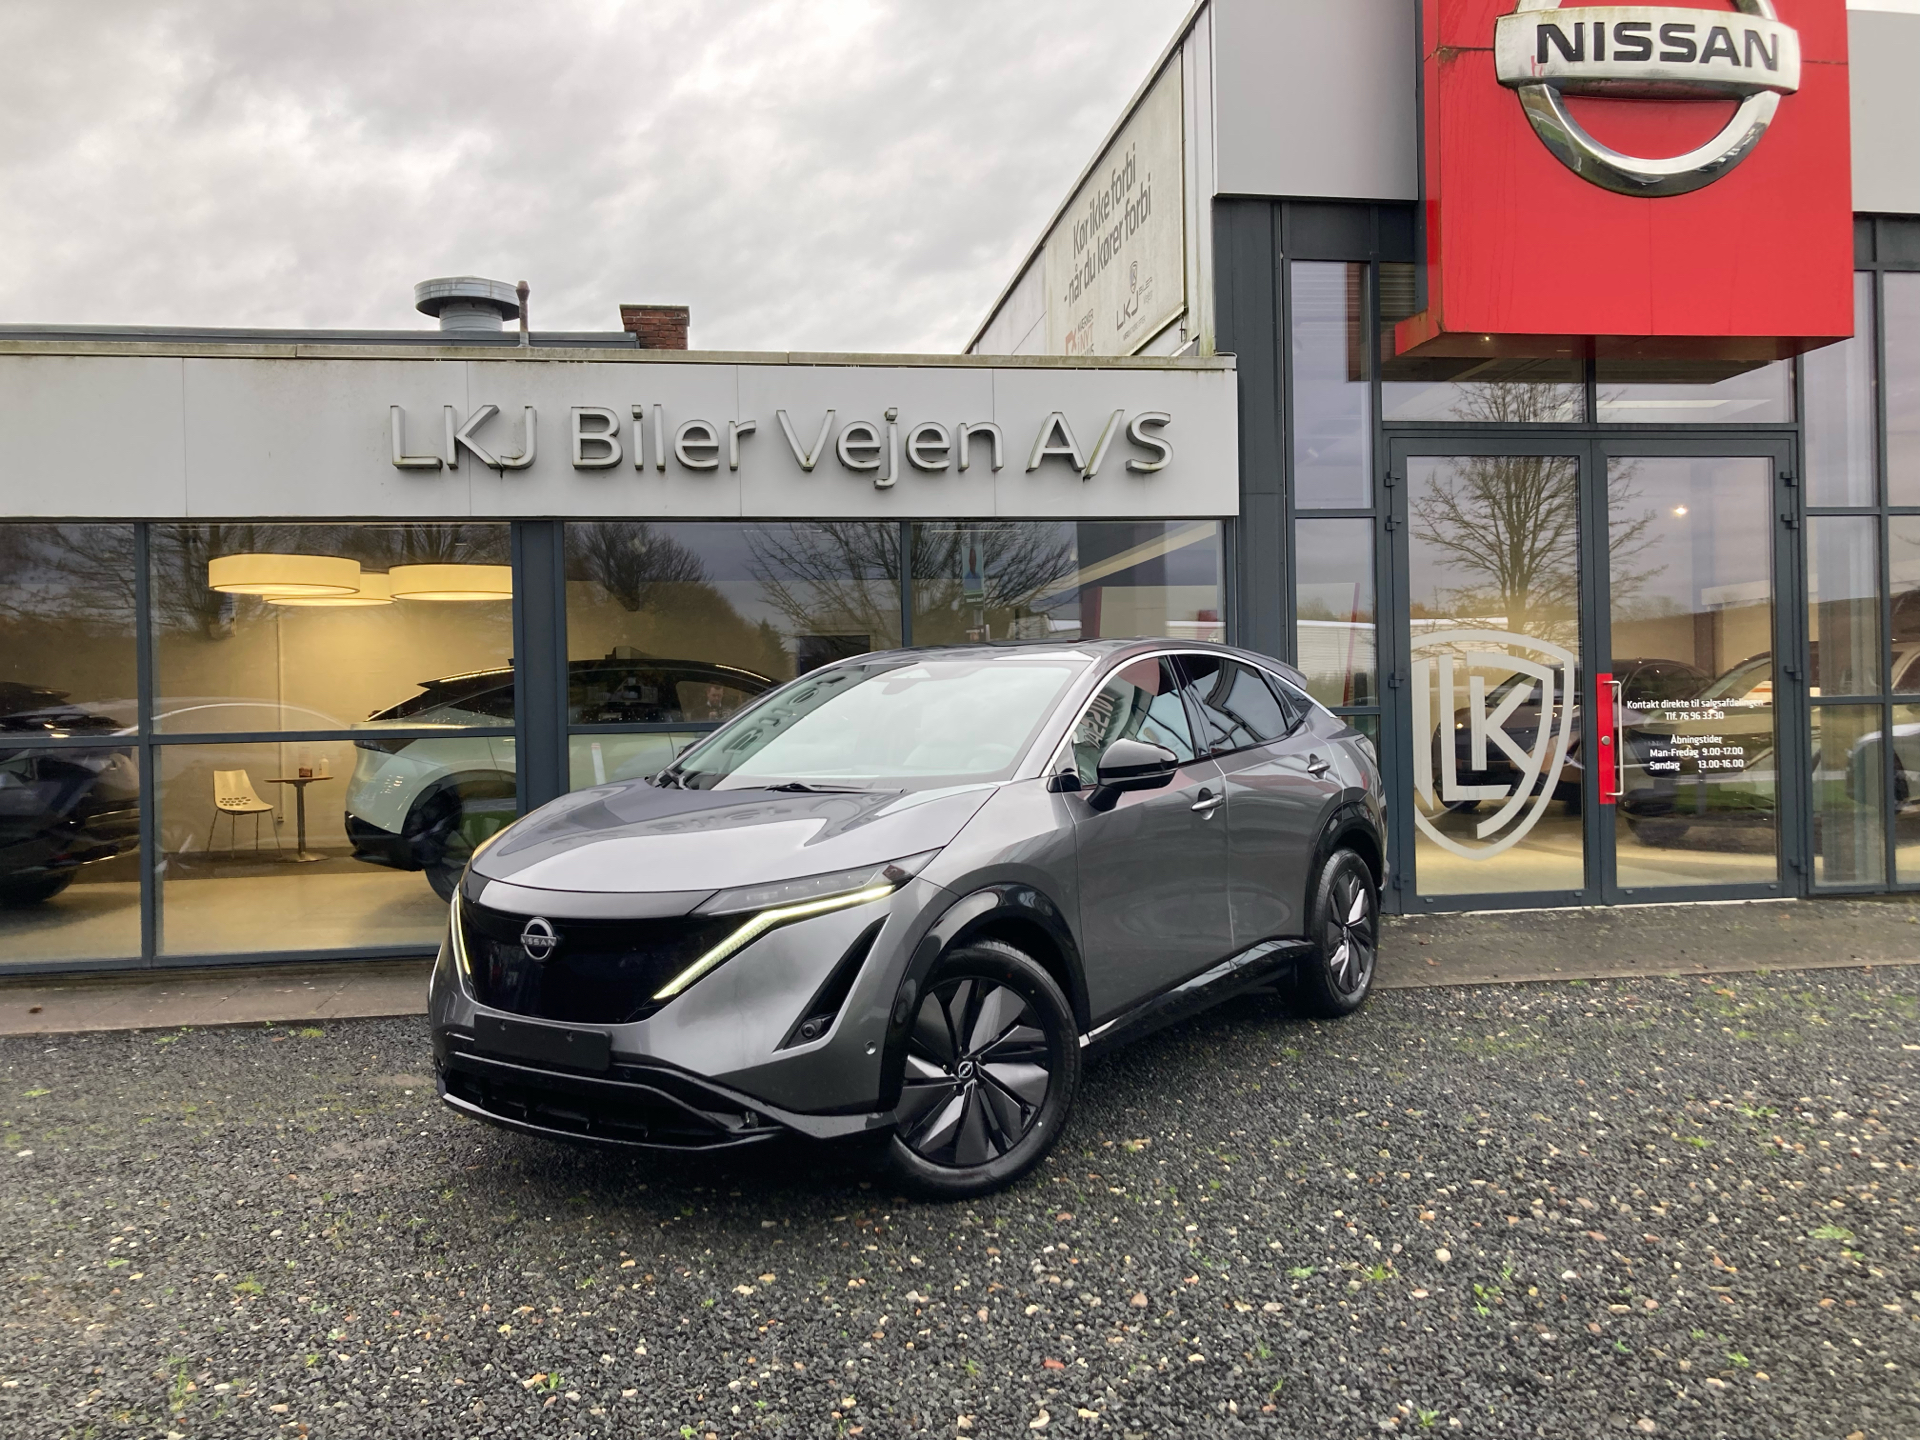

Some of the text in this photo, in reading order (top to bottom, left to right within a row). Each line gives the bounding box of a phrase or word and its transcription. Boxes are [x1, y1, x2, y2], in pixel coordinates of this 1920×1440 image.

[1536, 22, 1779, 71] NISSAN
[1073, 141, 1136, 260] Kør ikke forbi
[1084, 249, 1096, 289] du
[1098, 217, 1123, 274] kører
[1125, 172, 1151, 242] forbi
[390, 404, 1174, 490] LKJ Biler Vejen A/S
[1626, 697, 1764, 709] Kontakt direkte til salgsafdelingen
[1665, 711, 1678, 720] Tlf.
[1679, 711, 1689, 720] 76
[1690, 711, 1701, 720] 96
[1670, 734, 1723, 745] Åbningstider
[1649, 747, 1744, 758] Man-Fredag 9.00-17.00
[1649, 759, 1744, 771] Søndag 13.00-16.00
